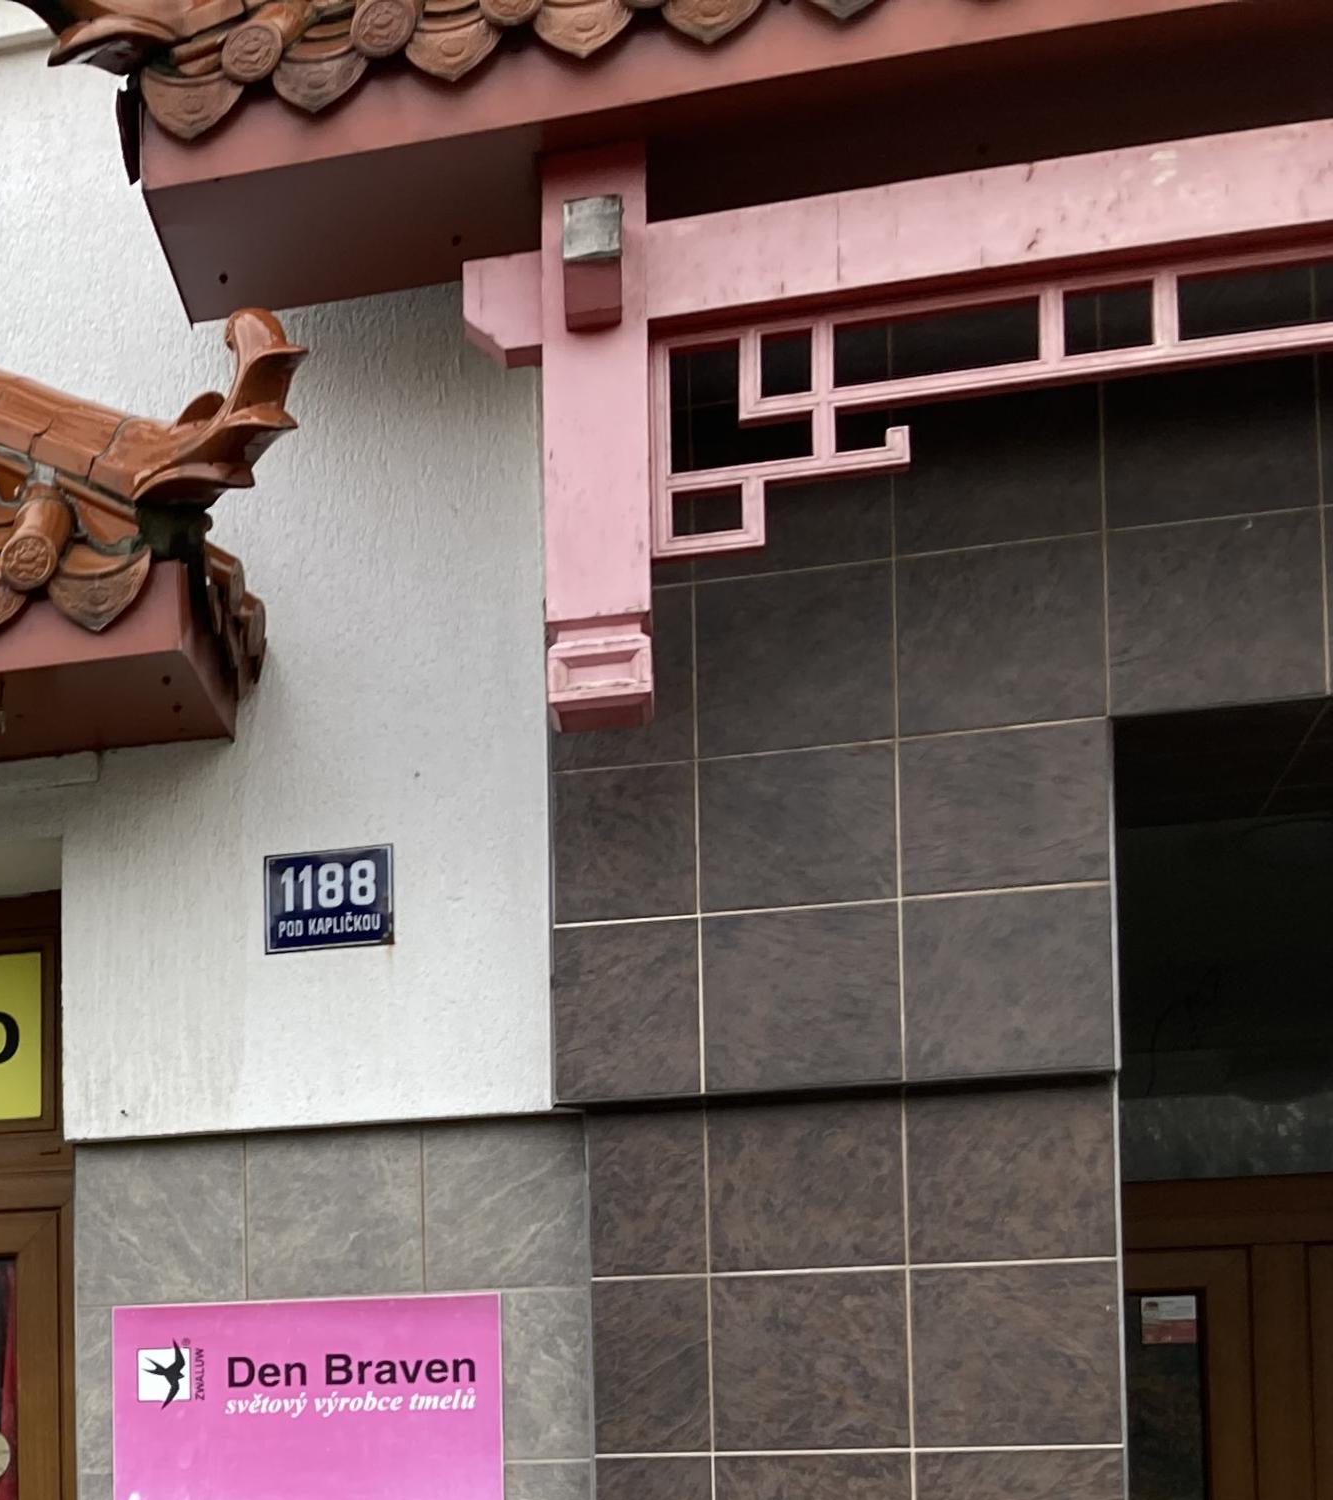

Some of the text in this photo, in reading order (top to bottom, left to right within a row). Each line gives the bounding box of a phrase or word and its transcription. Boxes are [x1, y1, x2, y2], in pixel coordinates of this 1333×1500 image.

[280, 859, 377, 912] 1188
[278, 912, 381, 938] POD KAPLIČKOU
[194, 1347, 206, 1401] ZWALUW
[227, 1353, 476, 1389] Den Braven
[225, 1387, 477, 1418] světový výrobce tmelů
